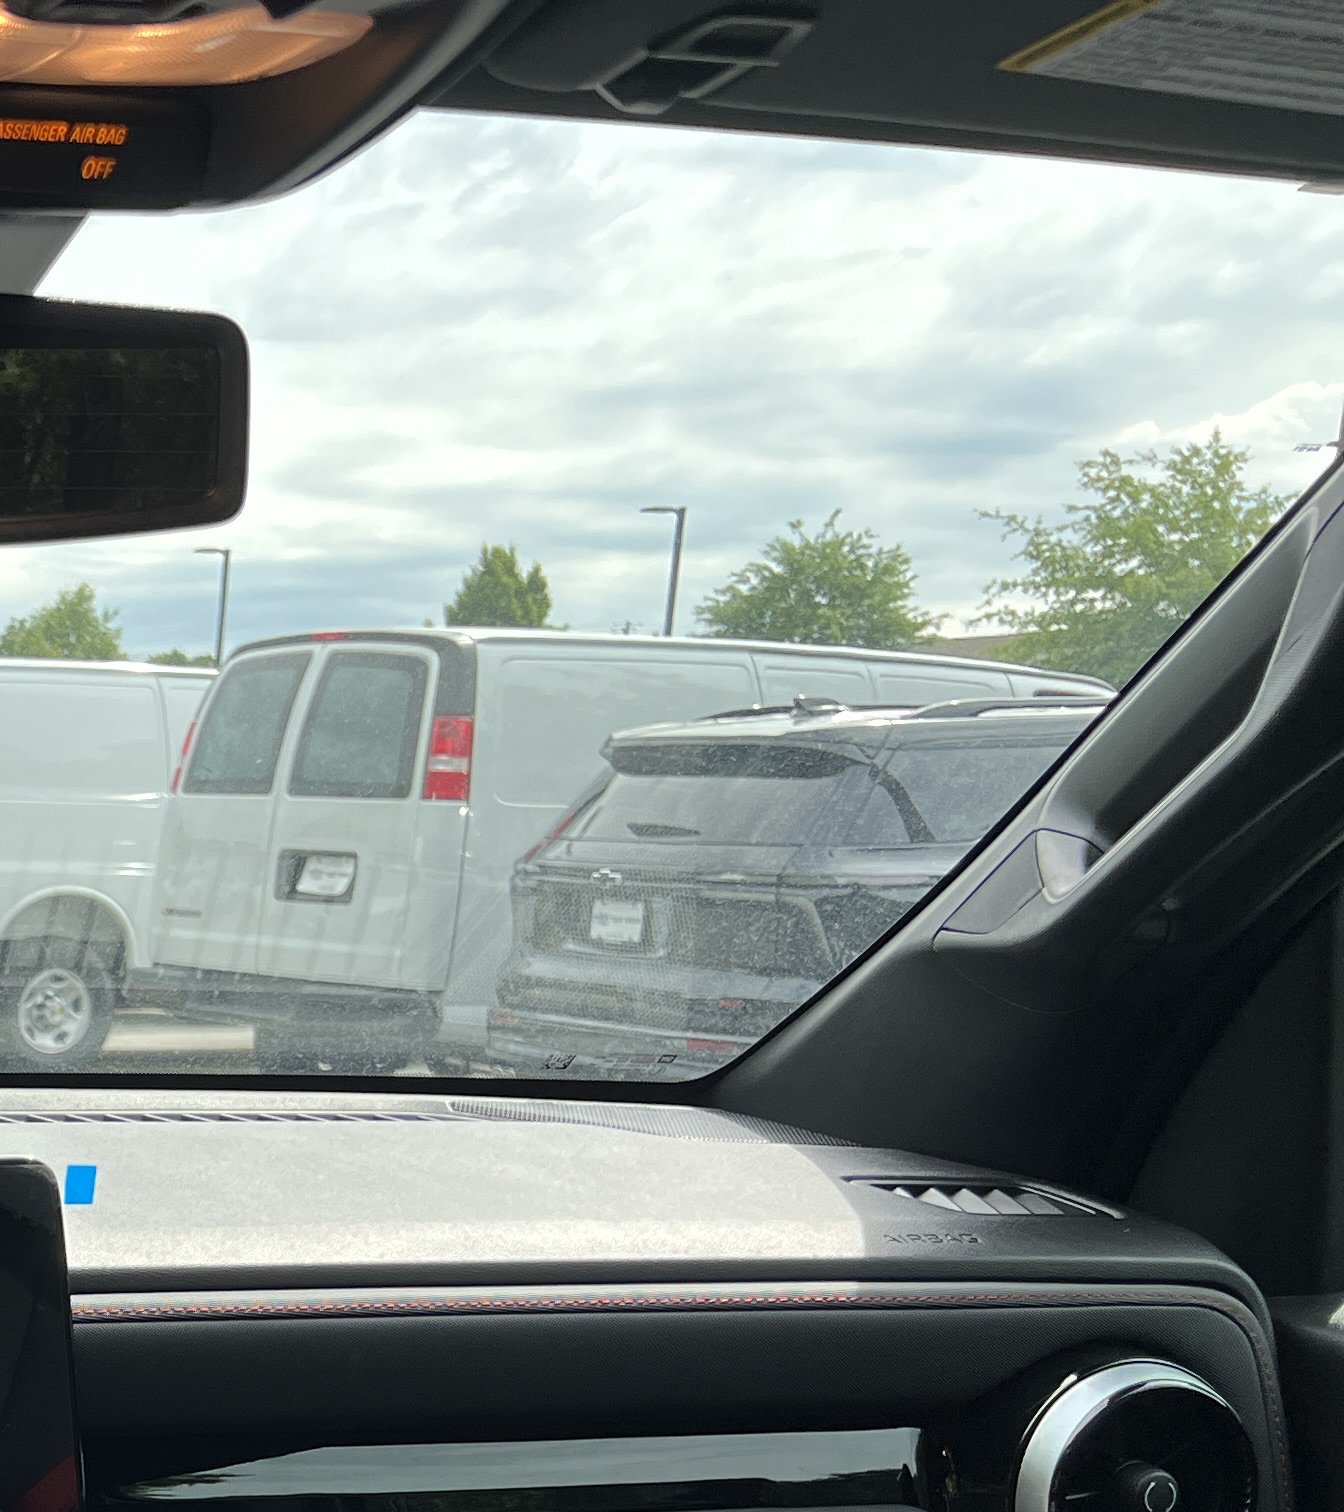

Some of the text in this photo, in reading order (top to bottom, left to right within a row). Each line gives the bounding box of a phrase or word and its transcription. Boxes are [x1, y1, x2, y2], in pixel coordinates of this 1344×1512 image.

[69, 123, 96, 144] AIR
[96, 124, 128, 145] BAG
[81, 156, 117, 180] OFF
